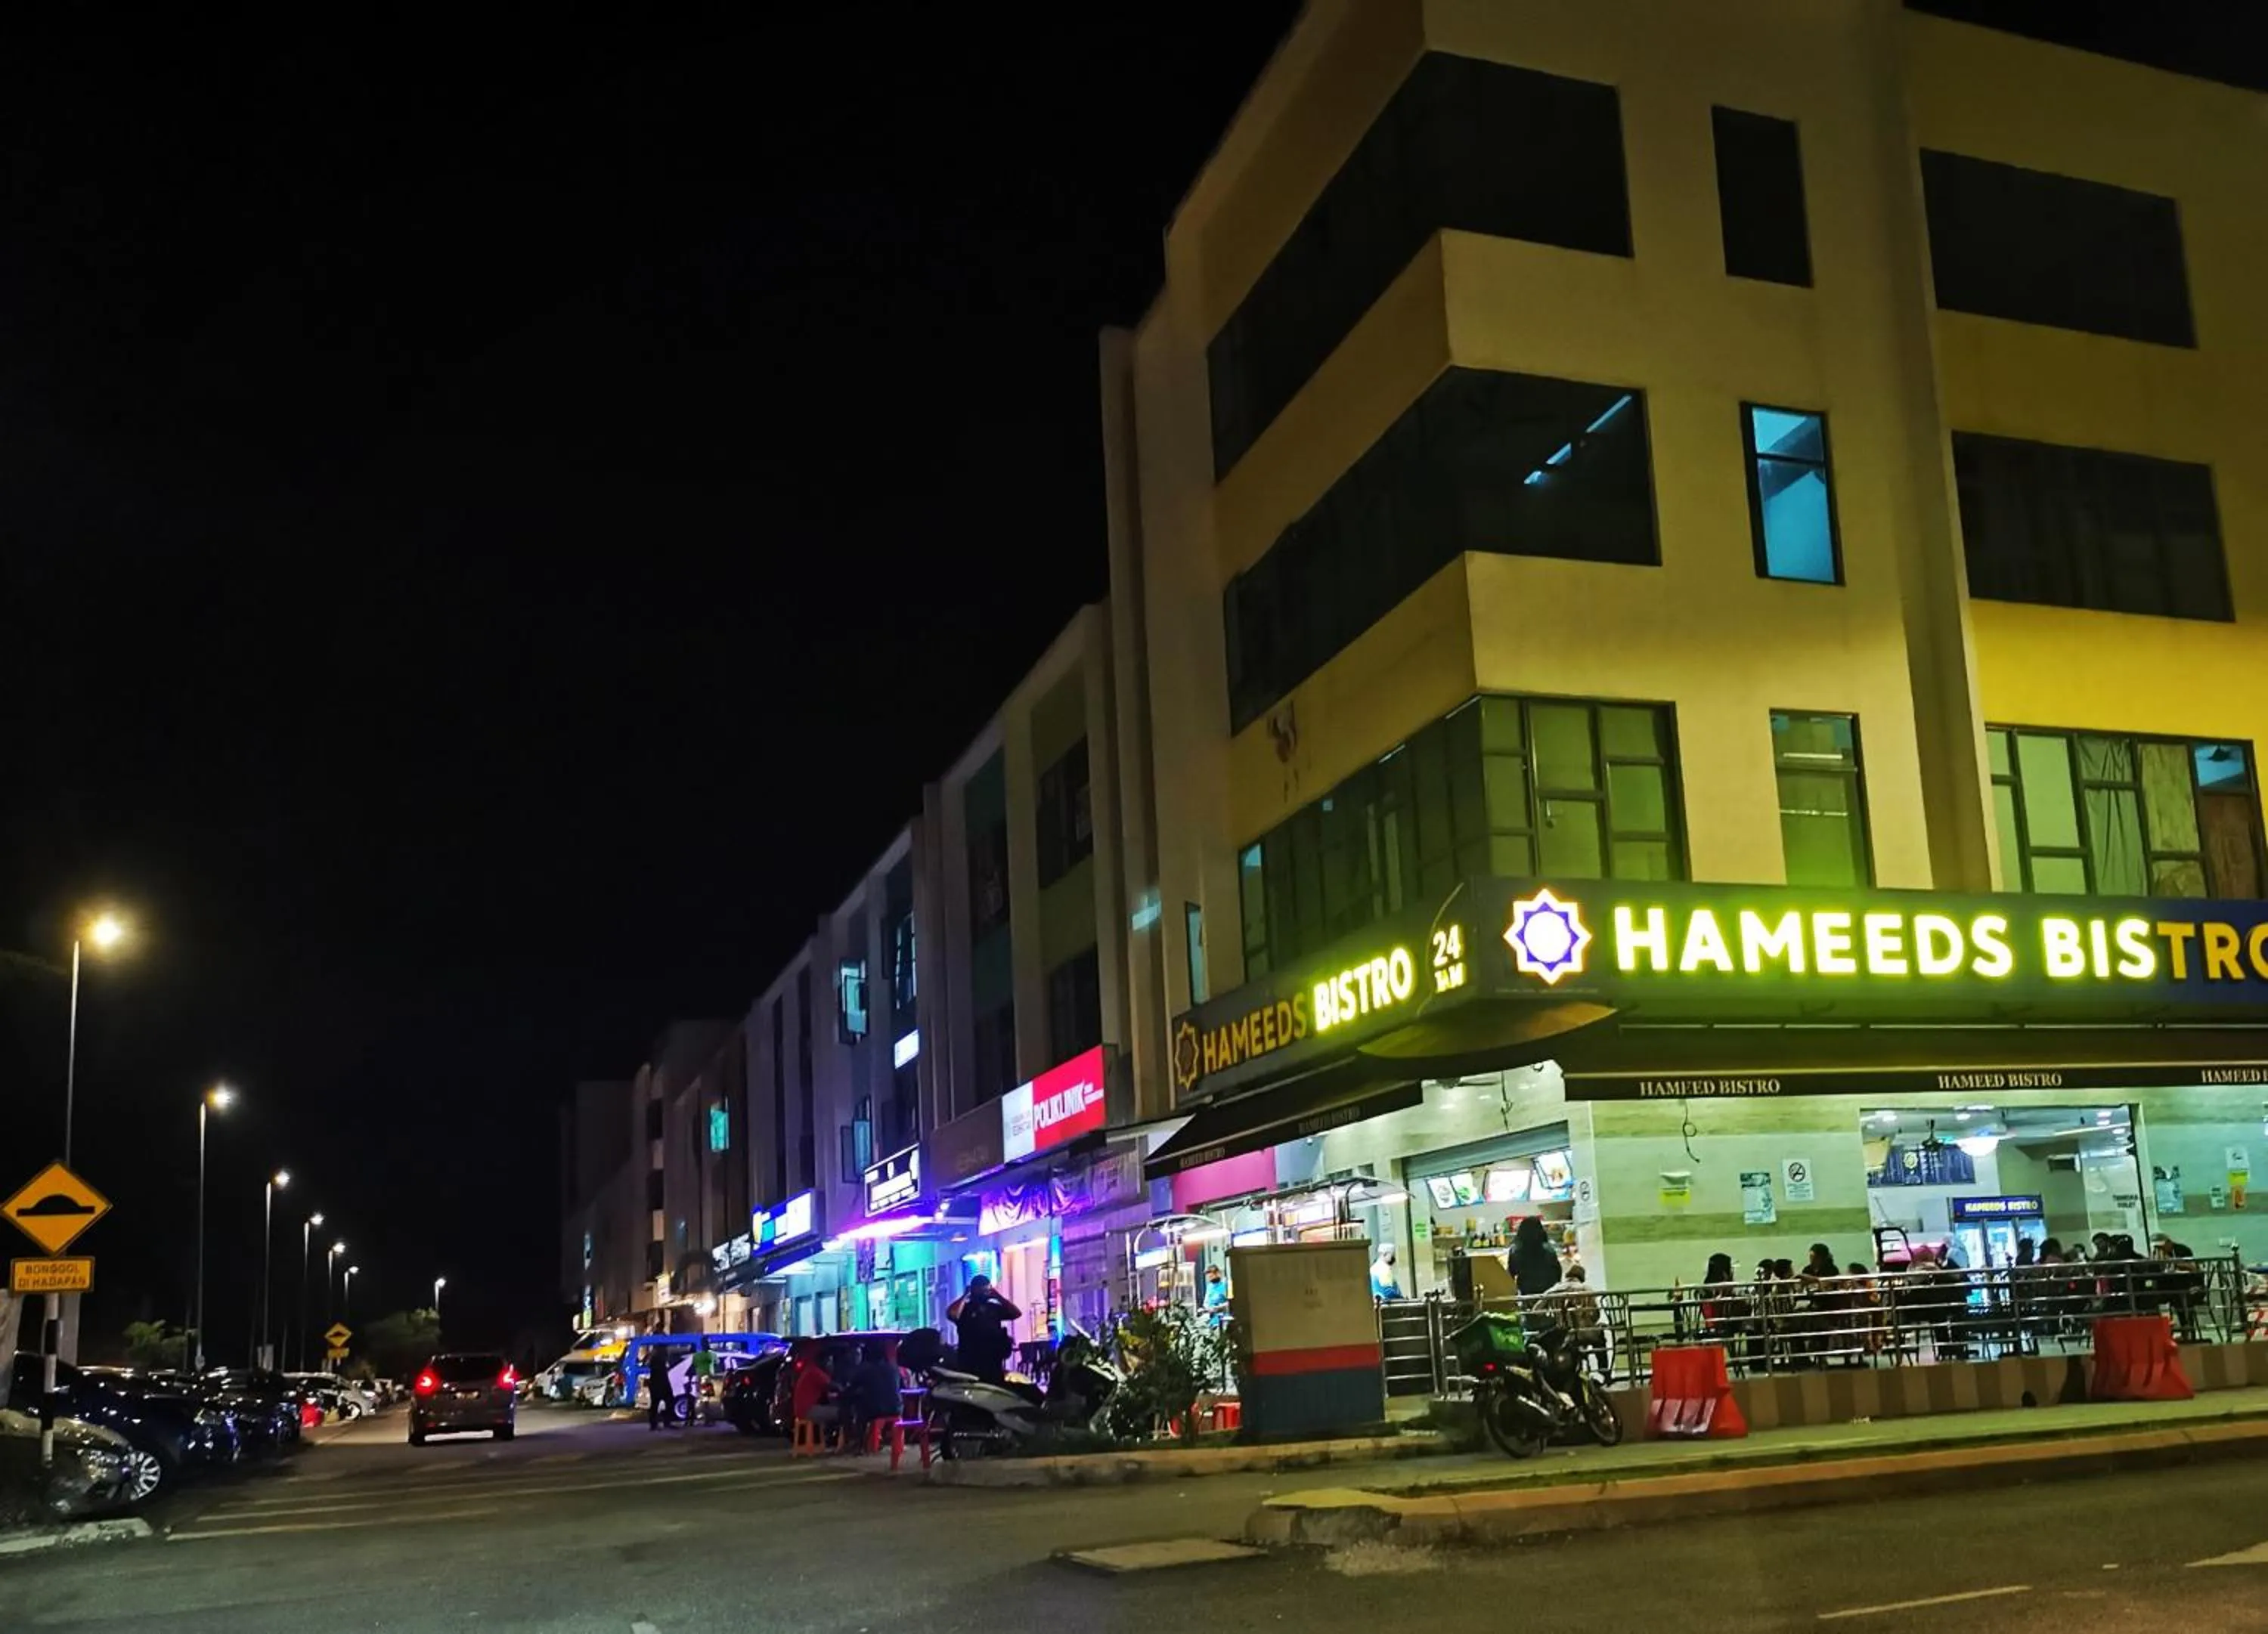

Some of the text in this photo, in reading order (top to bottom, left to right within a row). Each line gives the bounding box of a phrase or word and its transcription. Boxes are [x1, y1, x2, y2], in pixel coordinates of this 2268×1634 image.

[1433, 924, 1461, 967] 24
[1613, 906, 2014, 978] HAMEEDS
[1203, 946, 1412, 1074] HAMEEDS BISTRO
[1640, 1079, 1780, 1096] HAMEED BISTRO
[1938, 1072, 2062, 1089] HAMEED BISTRO
[2201, 1069, 2260, 1083] HAMEED
[1034, 1081, 1086, 1131] POLIKLINIK
